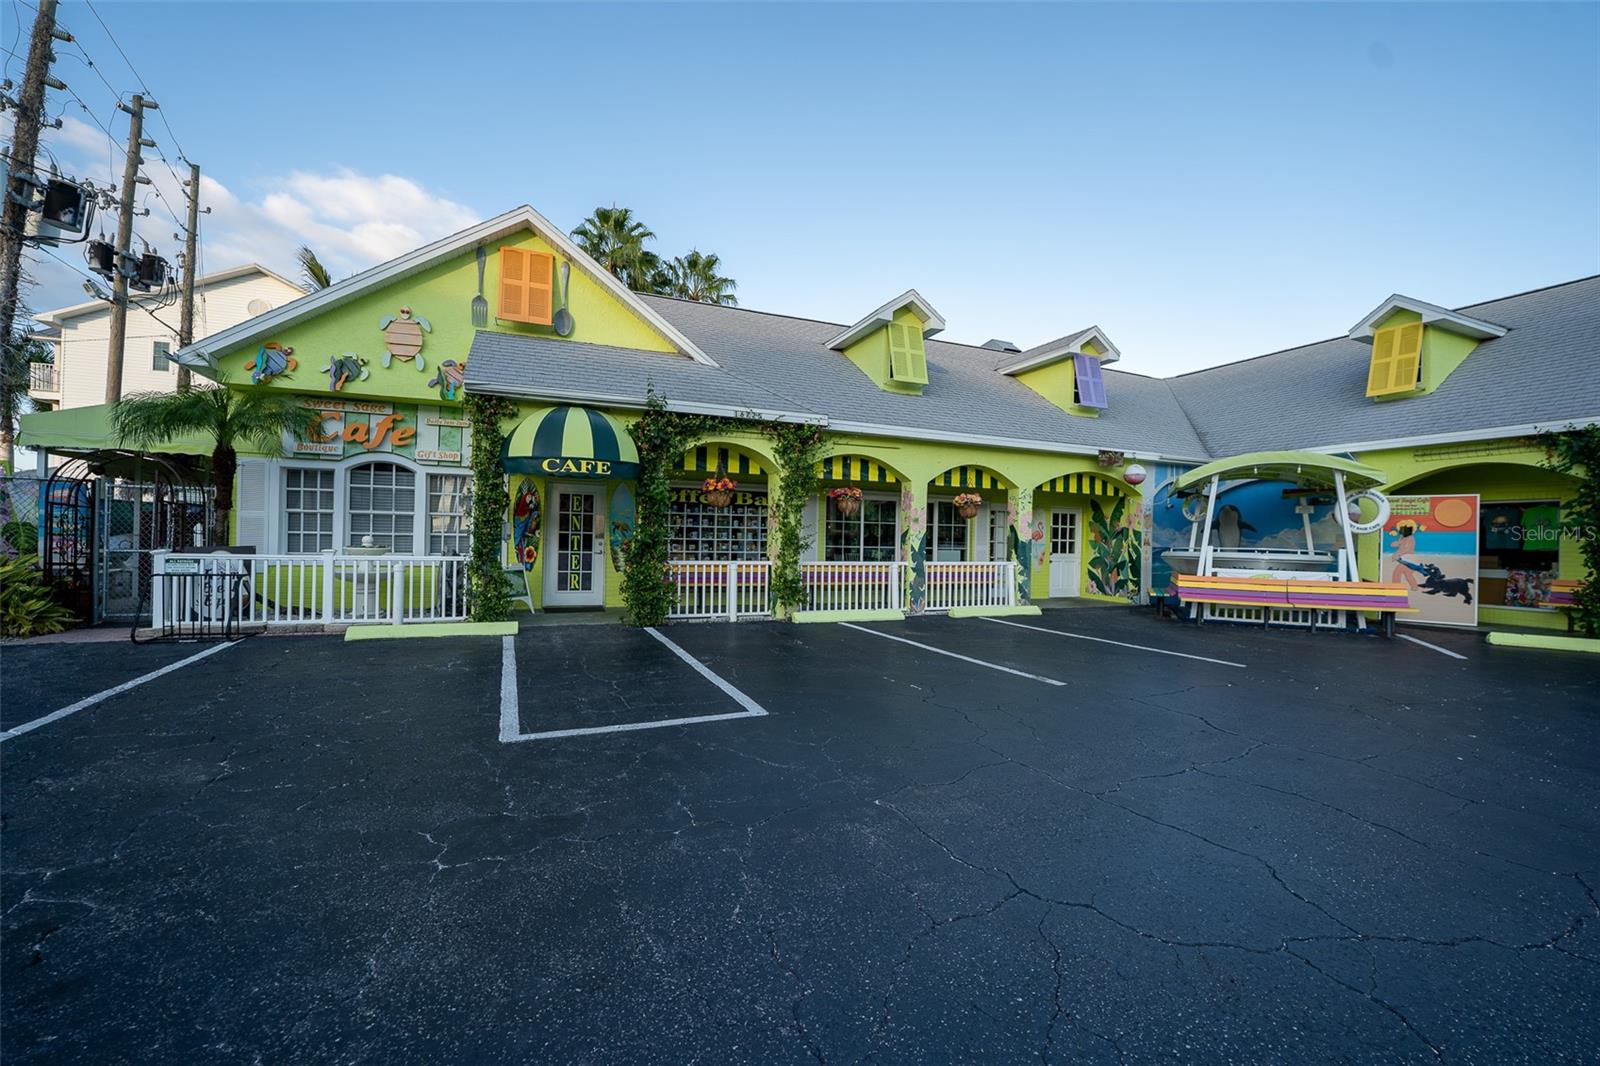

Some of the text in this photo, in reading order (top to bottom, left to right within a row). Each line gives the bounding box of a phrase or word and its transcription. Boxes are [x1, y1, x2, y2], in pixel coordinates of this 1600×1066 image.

[306, 411, 417, 450] Cafe
[416, 450, 460, 460] Gift Shop
[541, 458, 612, 475] CAFE
[570, 495, 582, 590] ENTER
